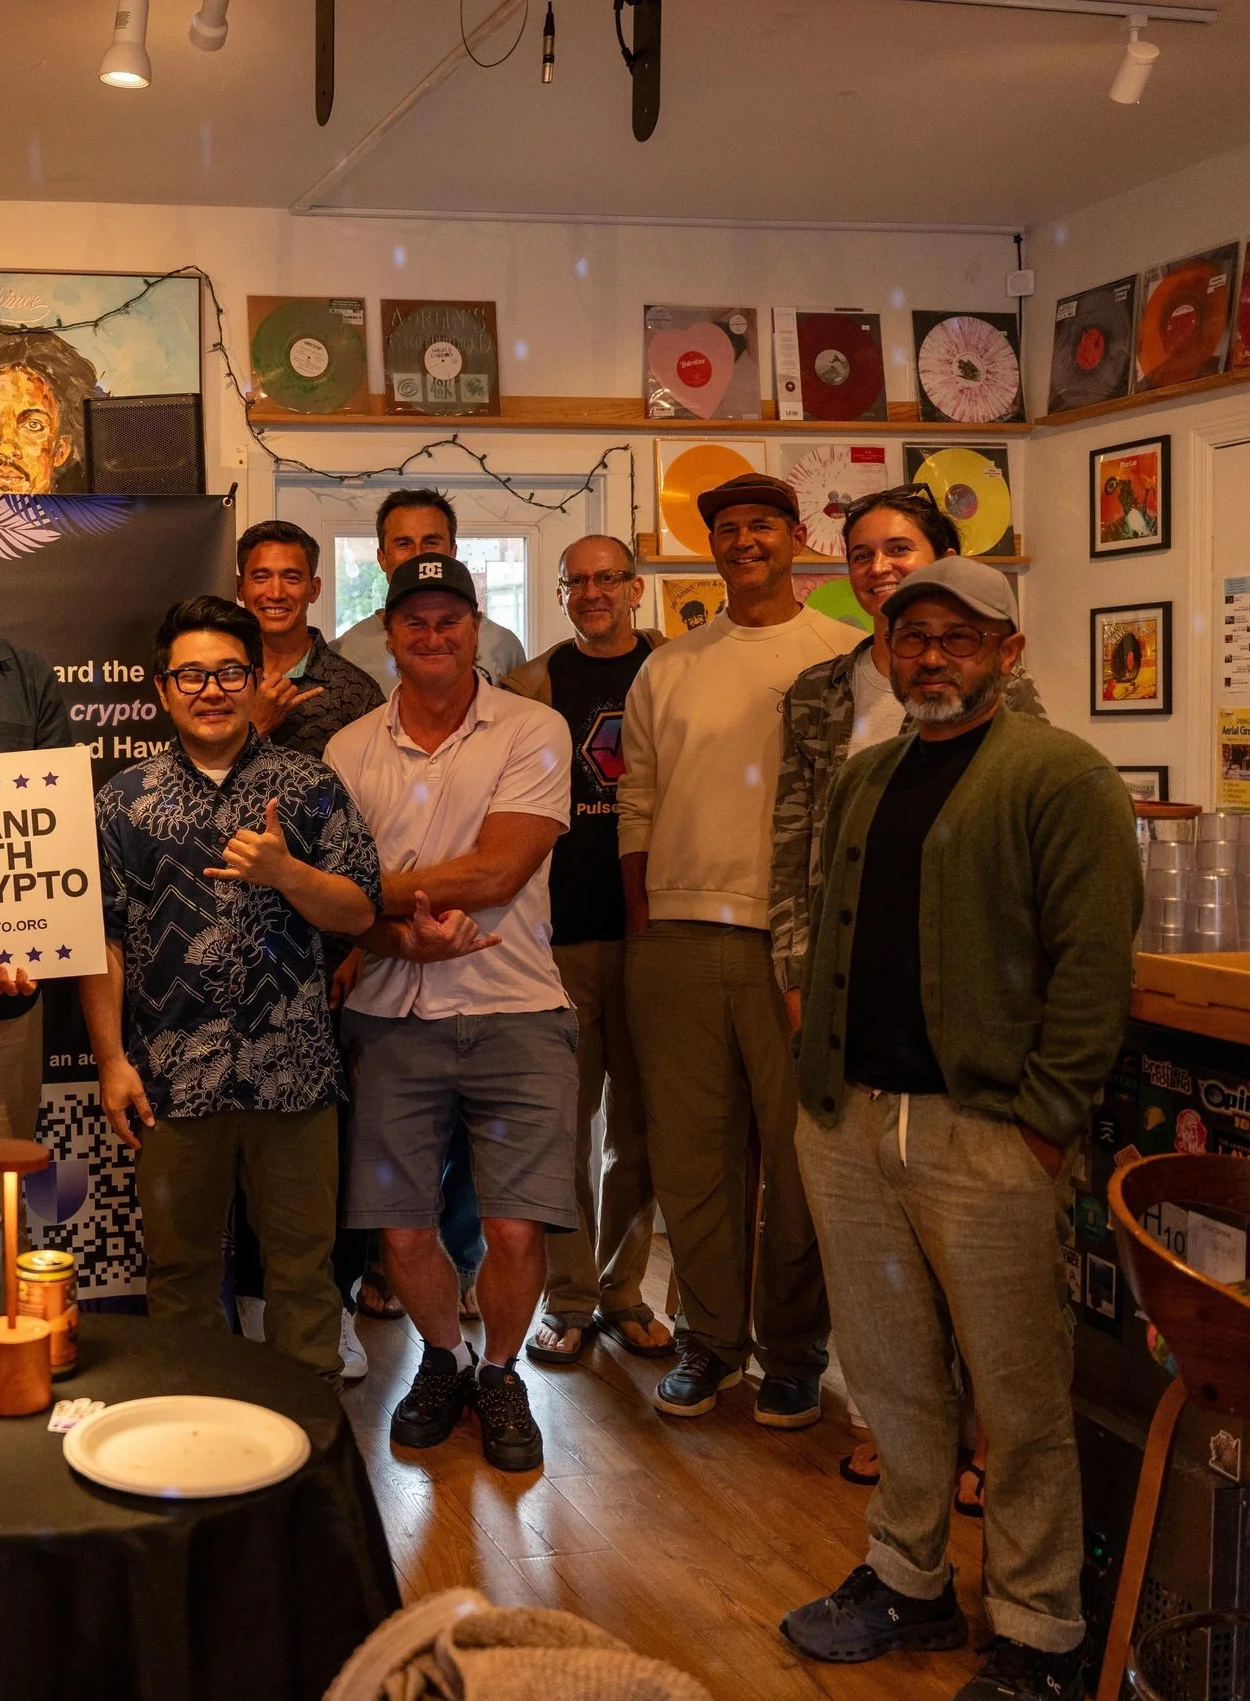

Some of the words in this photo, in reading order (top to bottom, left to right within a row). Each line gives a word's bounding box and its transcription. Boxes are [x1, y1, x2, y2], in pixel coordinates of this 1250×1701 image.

[102, 660, 145, 683] the
[70, 699, 157, 727] crypto
[49, 1053, 72, 1067] an
